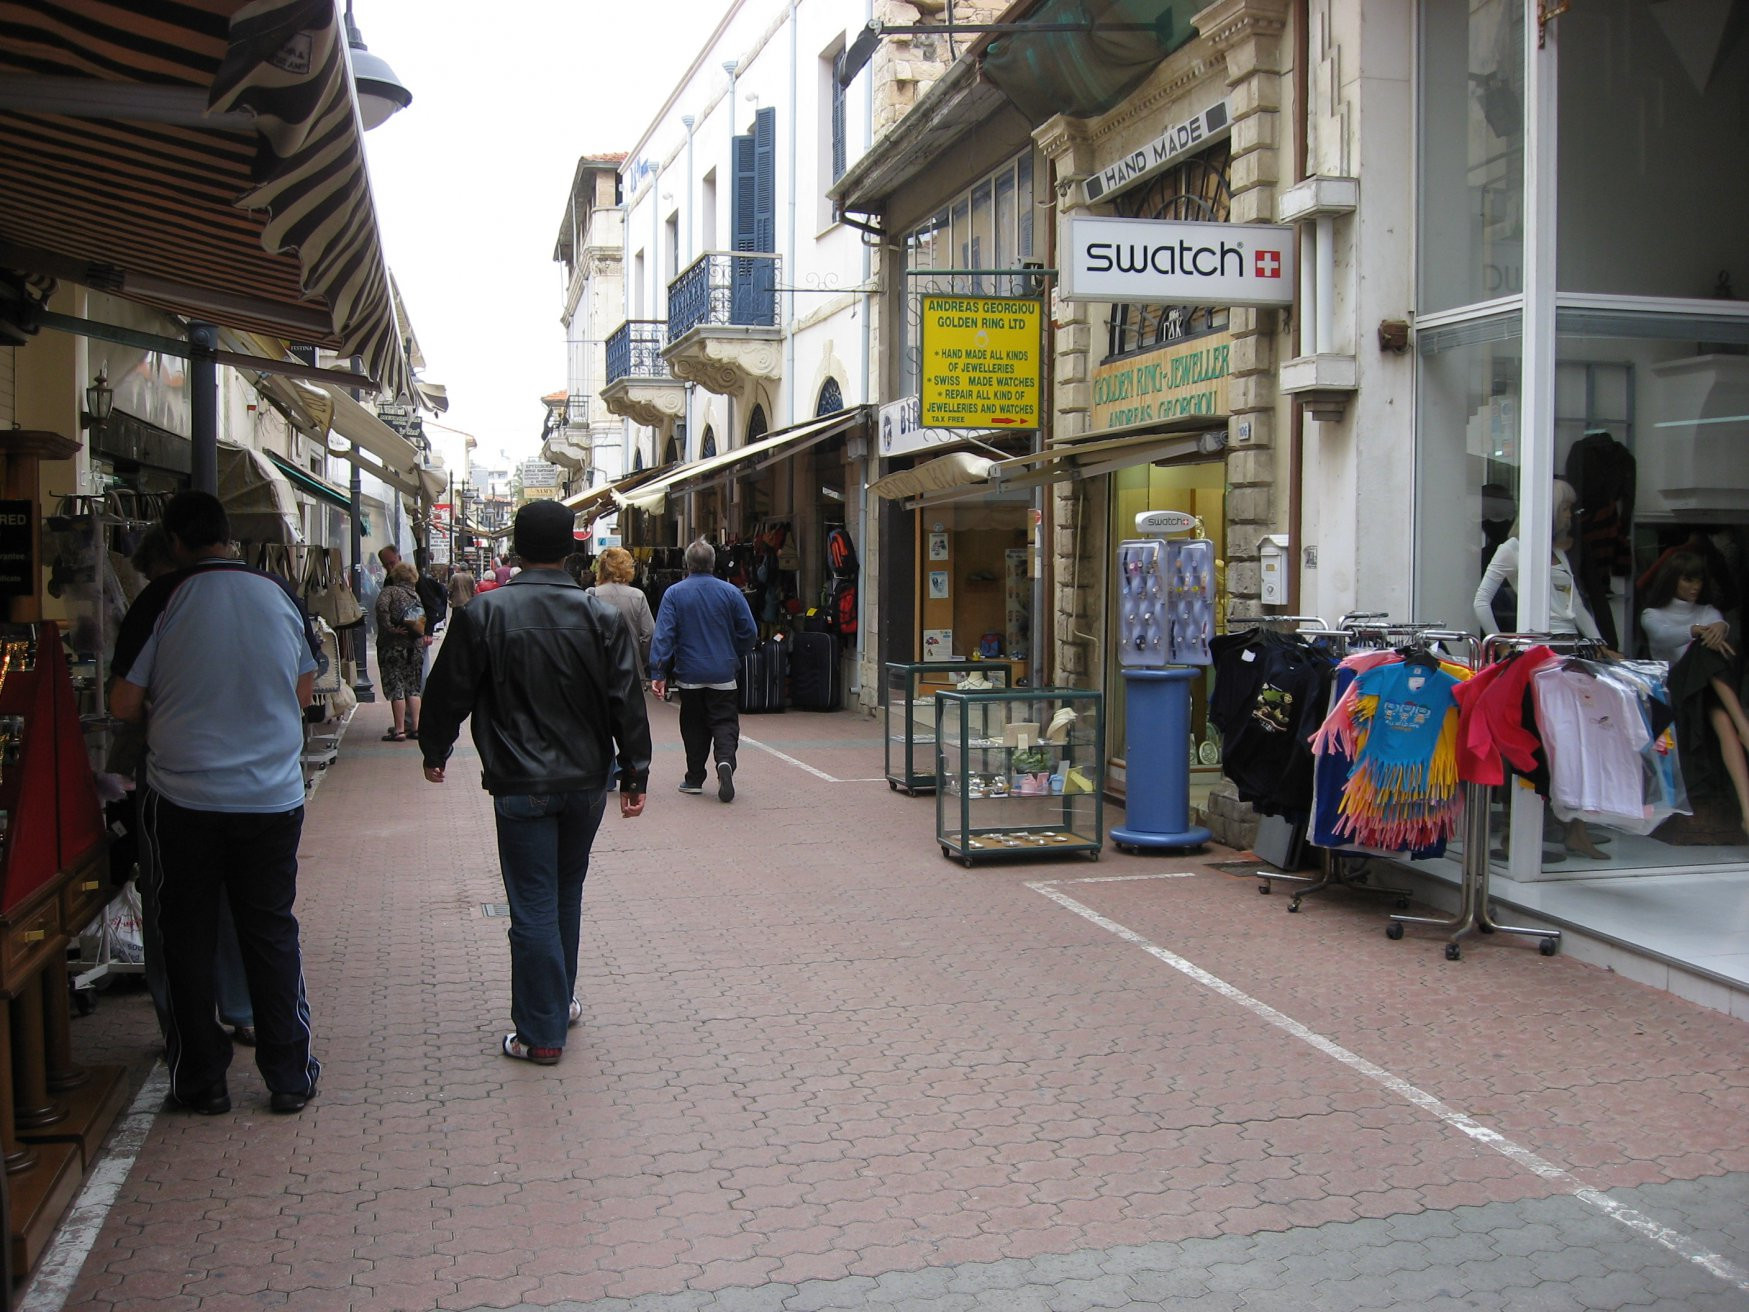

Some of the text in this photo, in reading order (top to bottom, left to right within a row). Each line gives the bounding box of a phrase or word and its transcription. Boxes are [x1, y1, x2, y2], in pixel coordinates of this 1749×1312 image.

[1105, 117, 1202, 190] HAND MADE
[1087, 239, 1243, 277] swatch
[928, 300, 1035, 314] ANDREAS GEORGIOU
[938, 316, 1025, 329] GOLDEN RING LTD
[942, 349, 1028, 360] HAND MADE ALL KINDS
[948, 363, 1014, 373] OF JEWELLERIES
[934, 376, 1034, 387] SWISS MADE WATCHES
[1093, 370, 1134, 405] GOLDEN
[945, 389, 1025, 401] REPAIR ALL KIND OF
[927, 403, 1033, 414] JEWELLERIES AND WATCHES
[1148, 517, 1183, 526] swatch
